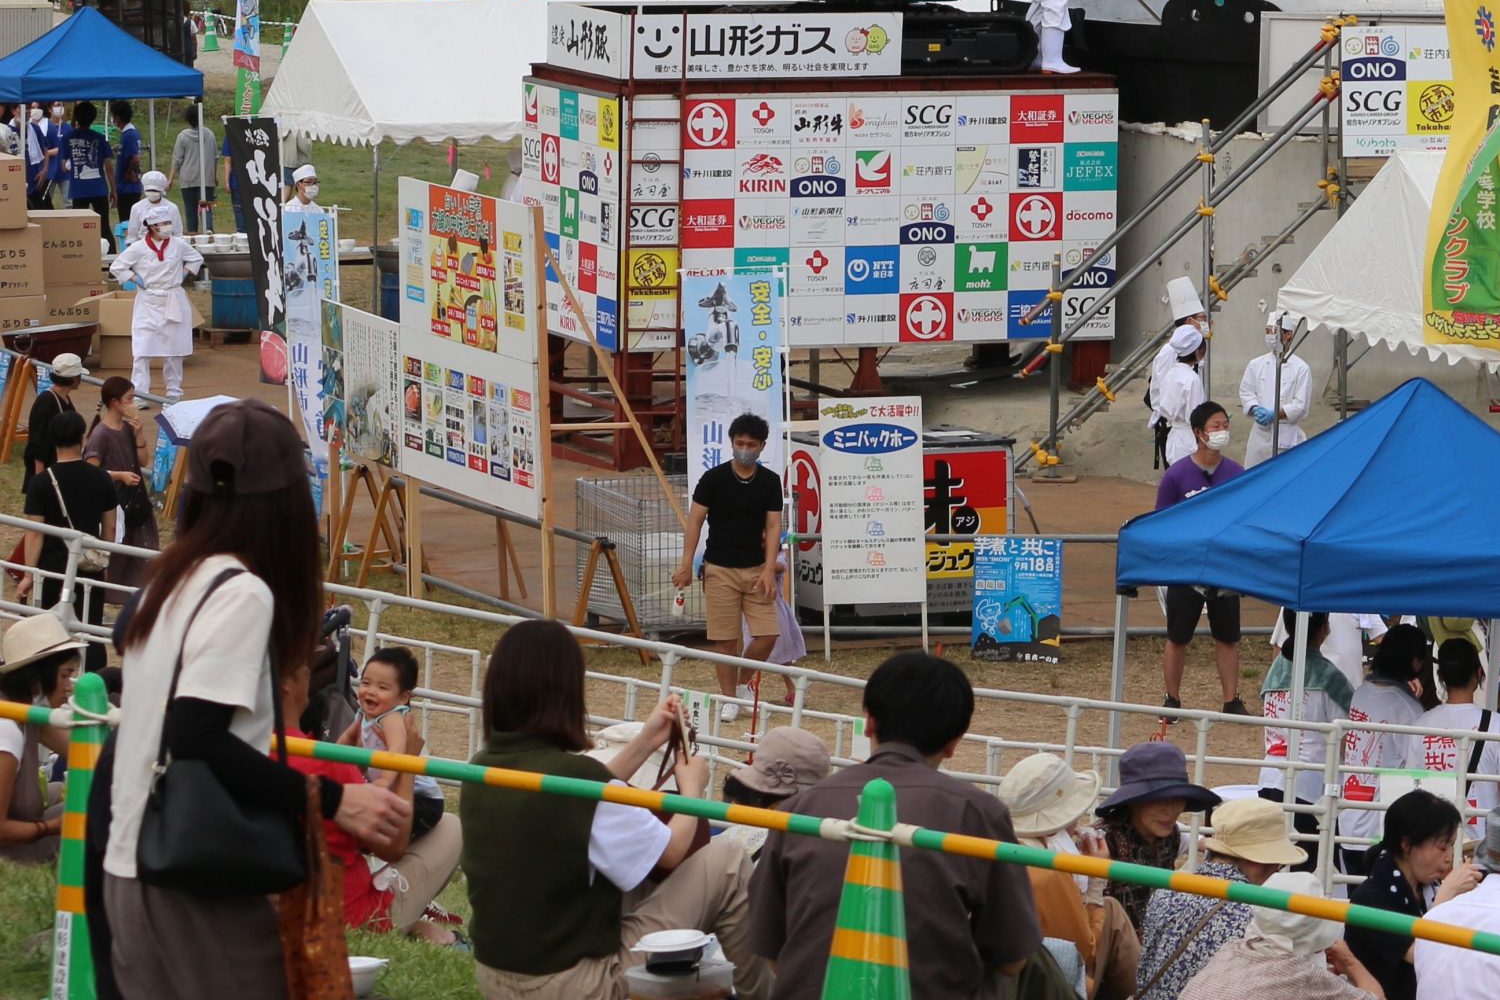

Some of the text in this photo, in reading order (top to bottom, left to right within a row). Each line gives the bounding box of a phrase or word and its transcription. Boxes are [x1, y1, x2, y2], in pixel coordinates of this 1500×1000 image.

[690, 24, 836, 57] 山形ガス
[1423, 48, 1451, 60] 荘内
[1350, 61, 1396, 79] ONO
[1347, 90, 1402, 112] SCG
[905, 104, 953, 125] SCG
[968, 116, 1008, 126] 升川建設
[1016, 109, 1057, 121] 大和証券
[794, 113, 843, 135] 山形牛
[1416, 123, 1451, 132] Takaha
[524, 137, 541, 159] SCG
[1356, 137, 1397, 148] Kubota
[692, 169, 732, 178] 升川建設
[915, 166, 953, 176] 荘内銀行
[1066, 165, 1114, 178] JEFEX
[581, 174, 596, 192] ONO
[739, 179, 786, 193] KIRIN
[798, 180, 838, 195] ONO
[630, 208, 675, 228] SCG
[686, 214, 728, 226] 大和証券
[1066, 209, 1114, 221] docomo
[908, 227, 947, 242] ONO
[0, 249, 26, 259] ぶりS
[872, 260, 895, 271] NTT
[1022, 260, 1051, 271] 荘内銀
[873, 271, 894, 279] 東日本
[49, 307, 90, 317] どんぶりS
[856, 313, 897, 323] 升川建設
[2, 318, 31, 328] ぶりS
[559, 314, 576, 332] KIRIN
[832, 430, 916, 448] ミニバックホー
[955, 515, 976, 528] アジ
[973, 537, 1054, 556] 芋煮と共に
[1424, 751, 1456, 772] 共に
